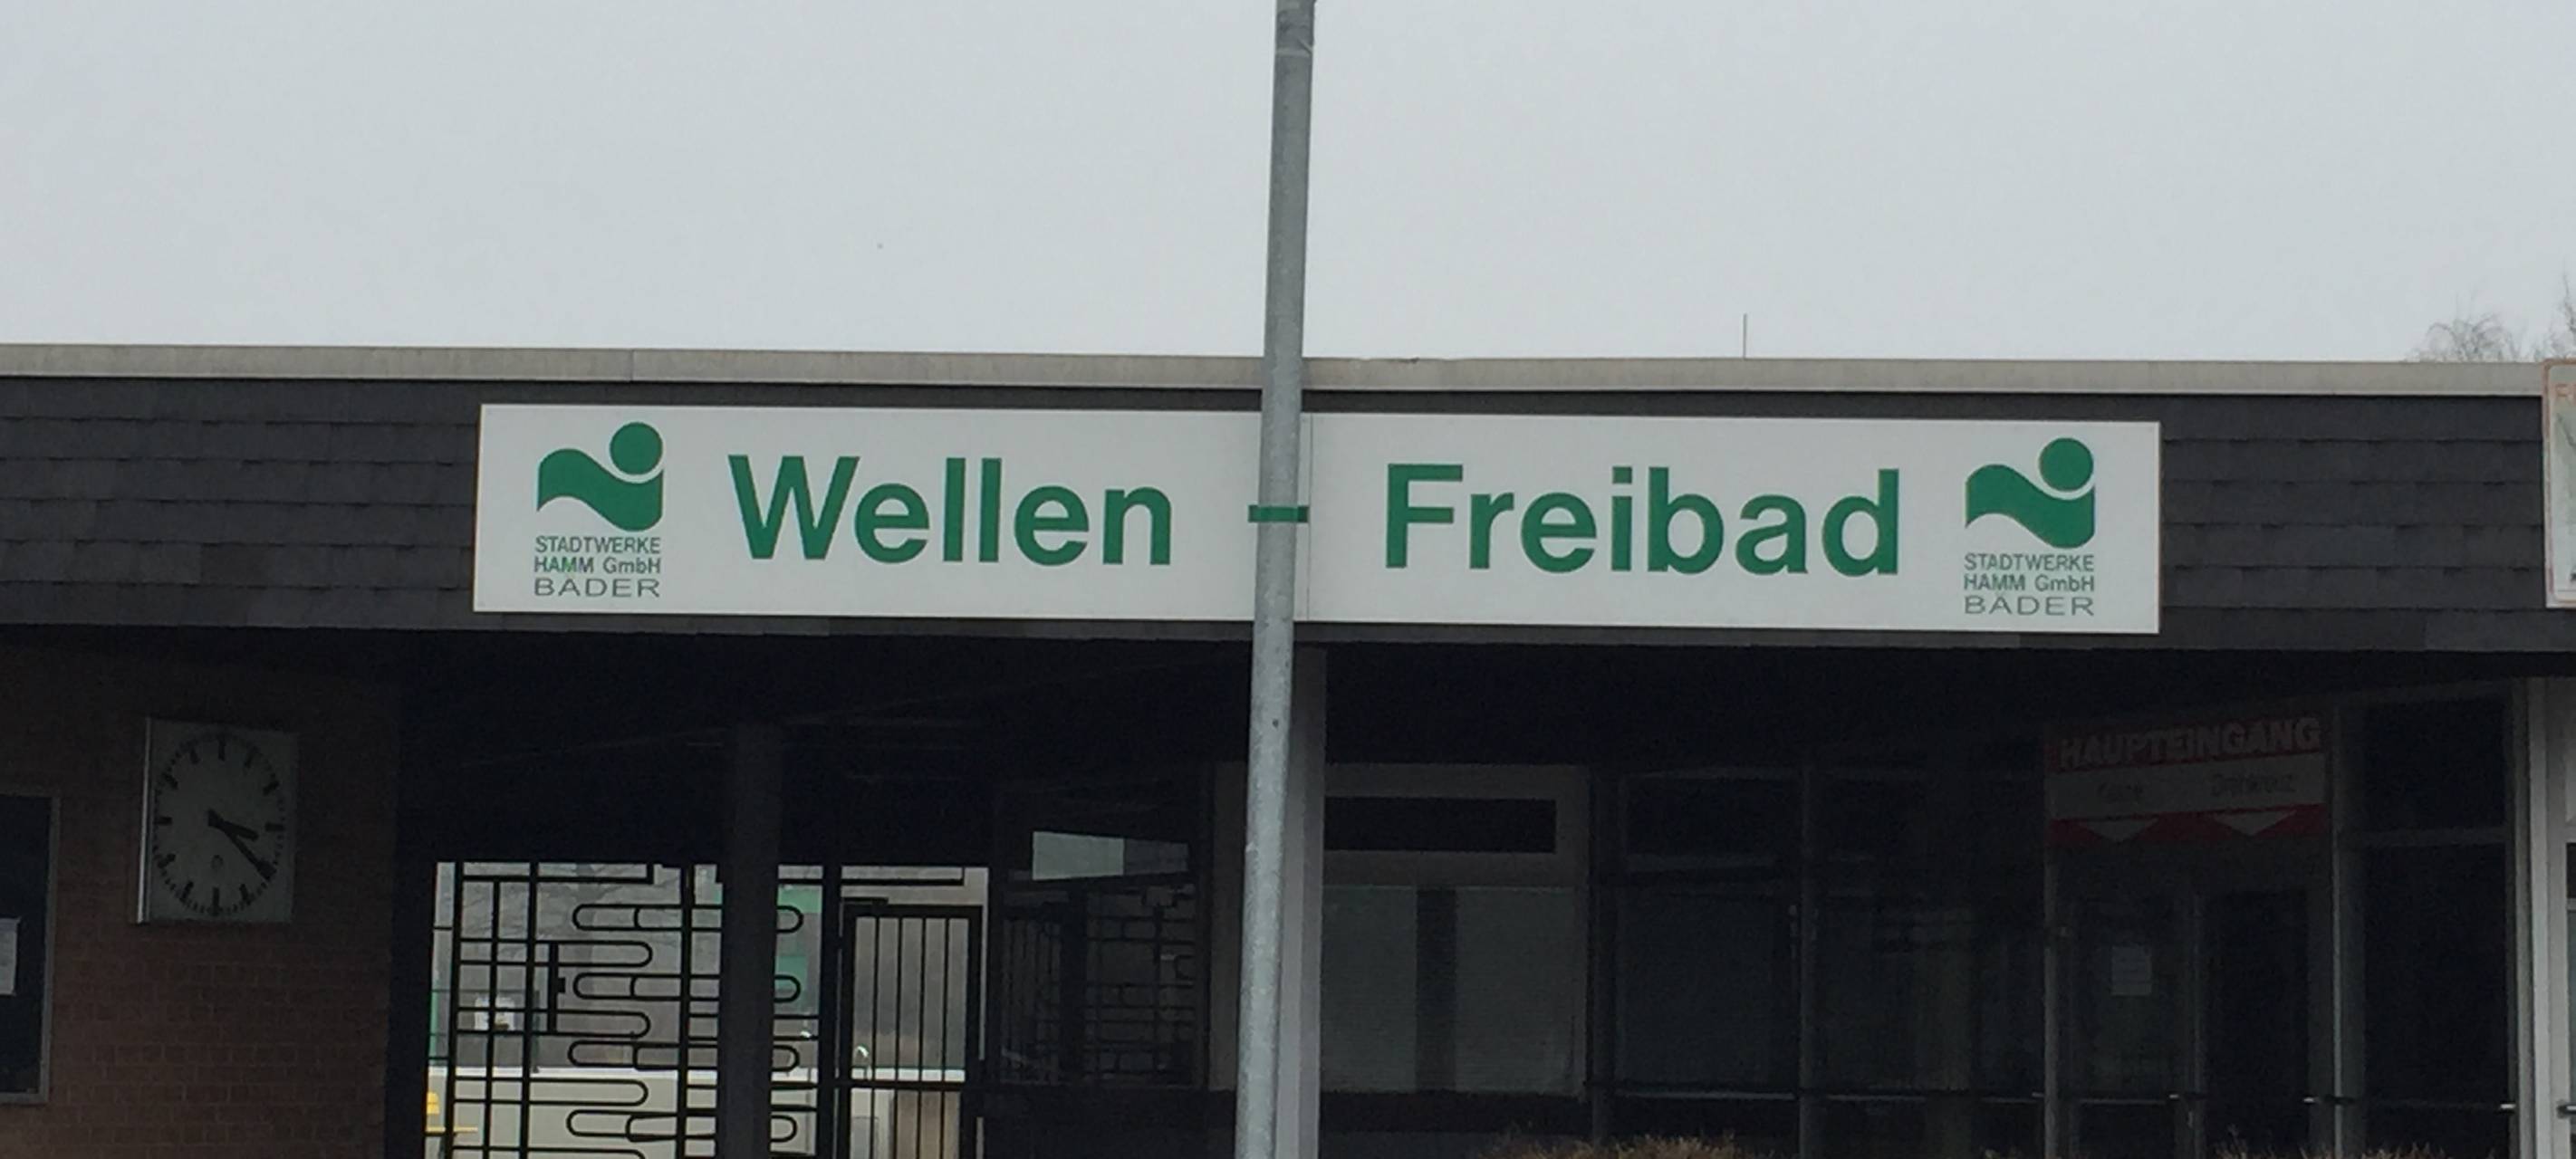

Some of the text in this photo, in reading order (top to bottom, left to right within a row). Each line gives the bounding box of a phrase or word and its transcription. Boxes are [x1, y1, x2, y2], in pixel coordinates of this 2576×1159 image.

[727, 452, 1173, 567] Wellen
[1384, 462, 1901, 577] Freibad
[534, 535, 661, 554] STADTWERKE
[533, 556, 661, 574] HAMM GmbH
[1963, 552, 2095, 572] STADTWERKE
[1963, 573, 2095, 592] HAMM GmbH
[2059, 716, 2321, 769] HAUPTEINGANG
